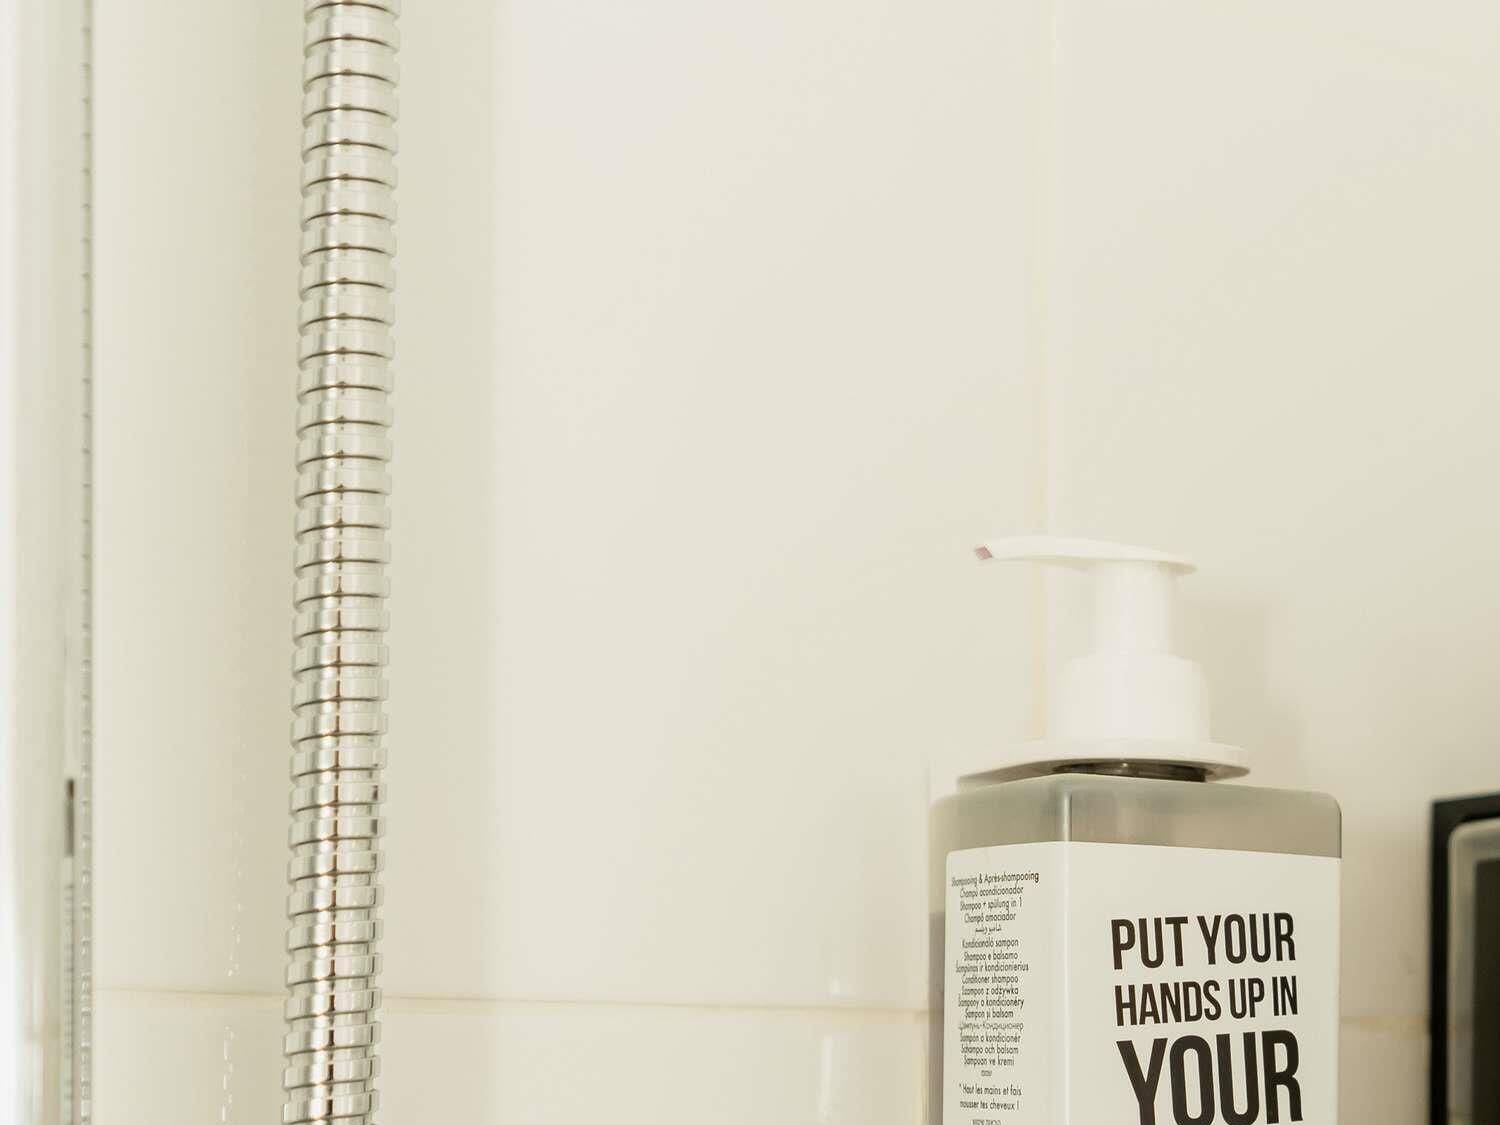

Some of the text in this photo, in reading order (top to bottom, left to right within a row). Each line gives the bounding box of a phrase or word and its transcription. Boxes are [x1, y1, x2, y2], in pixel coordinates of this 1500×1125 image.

[1110, 912, 1296, 970] PUT YOUR
[1114, 975, 1299, 1027] HANDS UP IN
